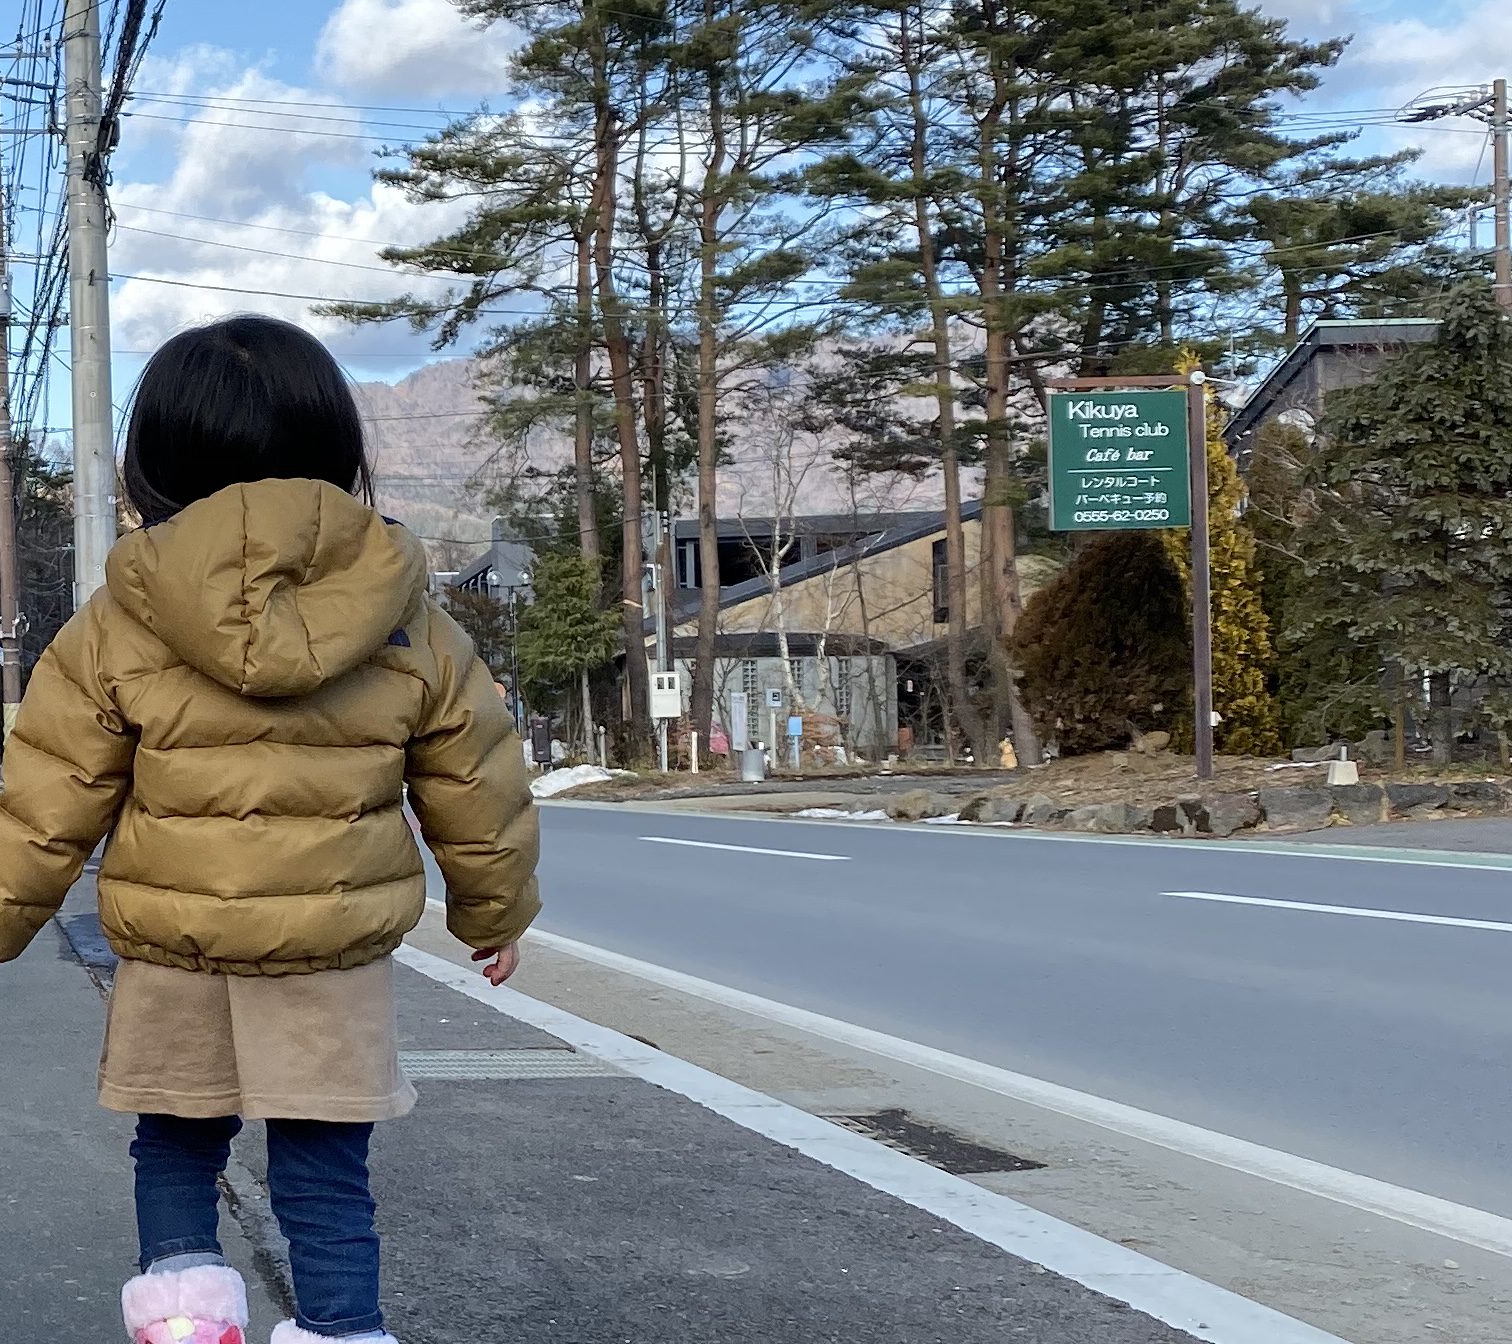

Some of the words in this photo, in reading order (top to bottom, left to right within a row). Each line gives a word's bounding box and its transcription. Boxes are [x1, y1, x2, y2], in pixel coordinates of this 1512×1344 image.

[1067, 401, 1138, 420] Kikuya
[1079, 424, 1132, 438] Tennis
[1135, 423, 1169, 437] club
[1127, 447, 1154, 461] bar
[1081, 476, 1160, 488] レンタルコート
[1075, 492, 1167, 505] バーベキュー予約
[1074, 509, 1169, 522] 0555-62-0250
